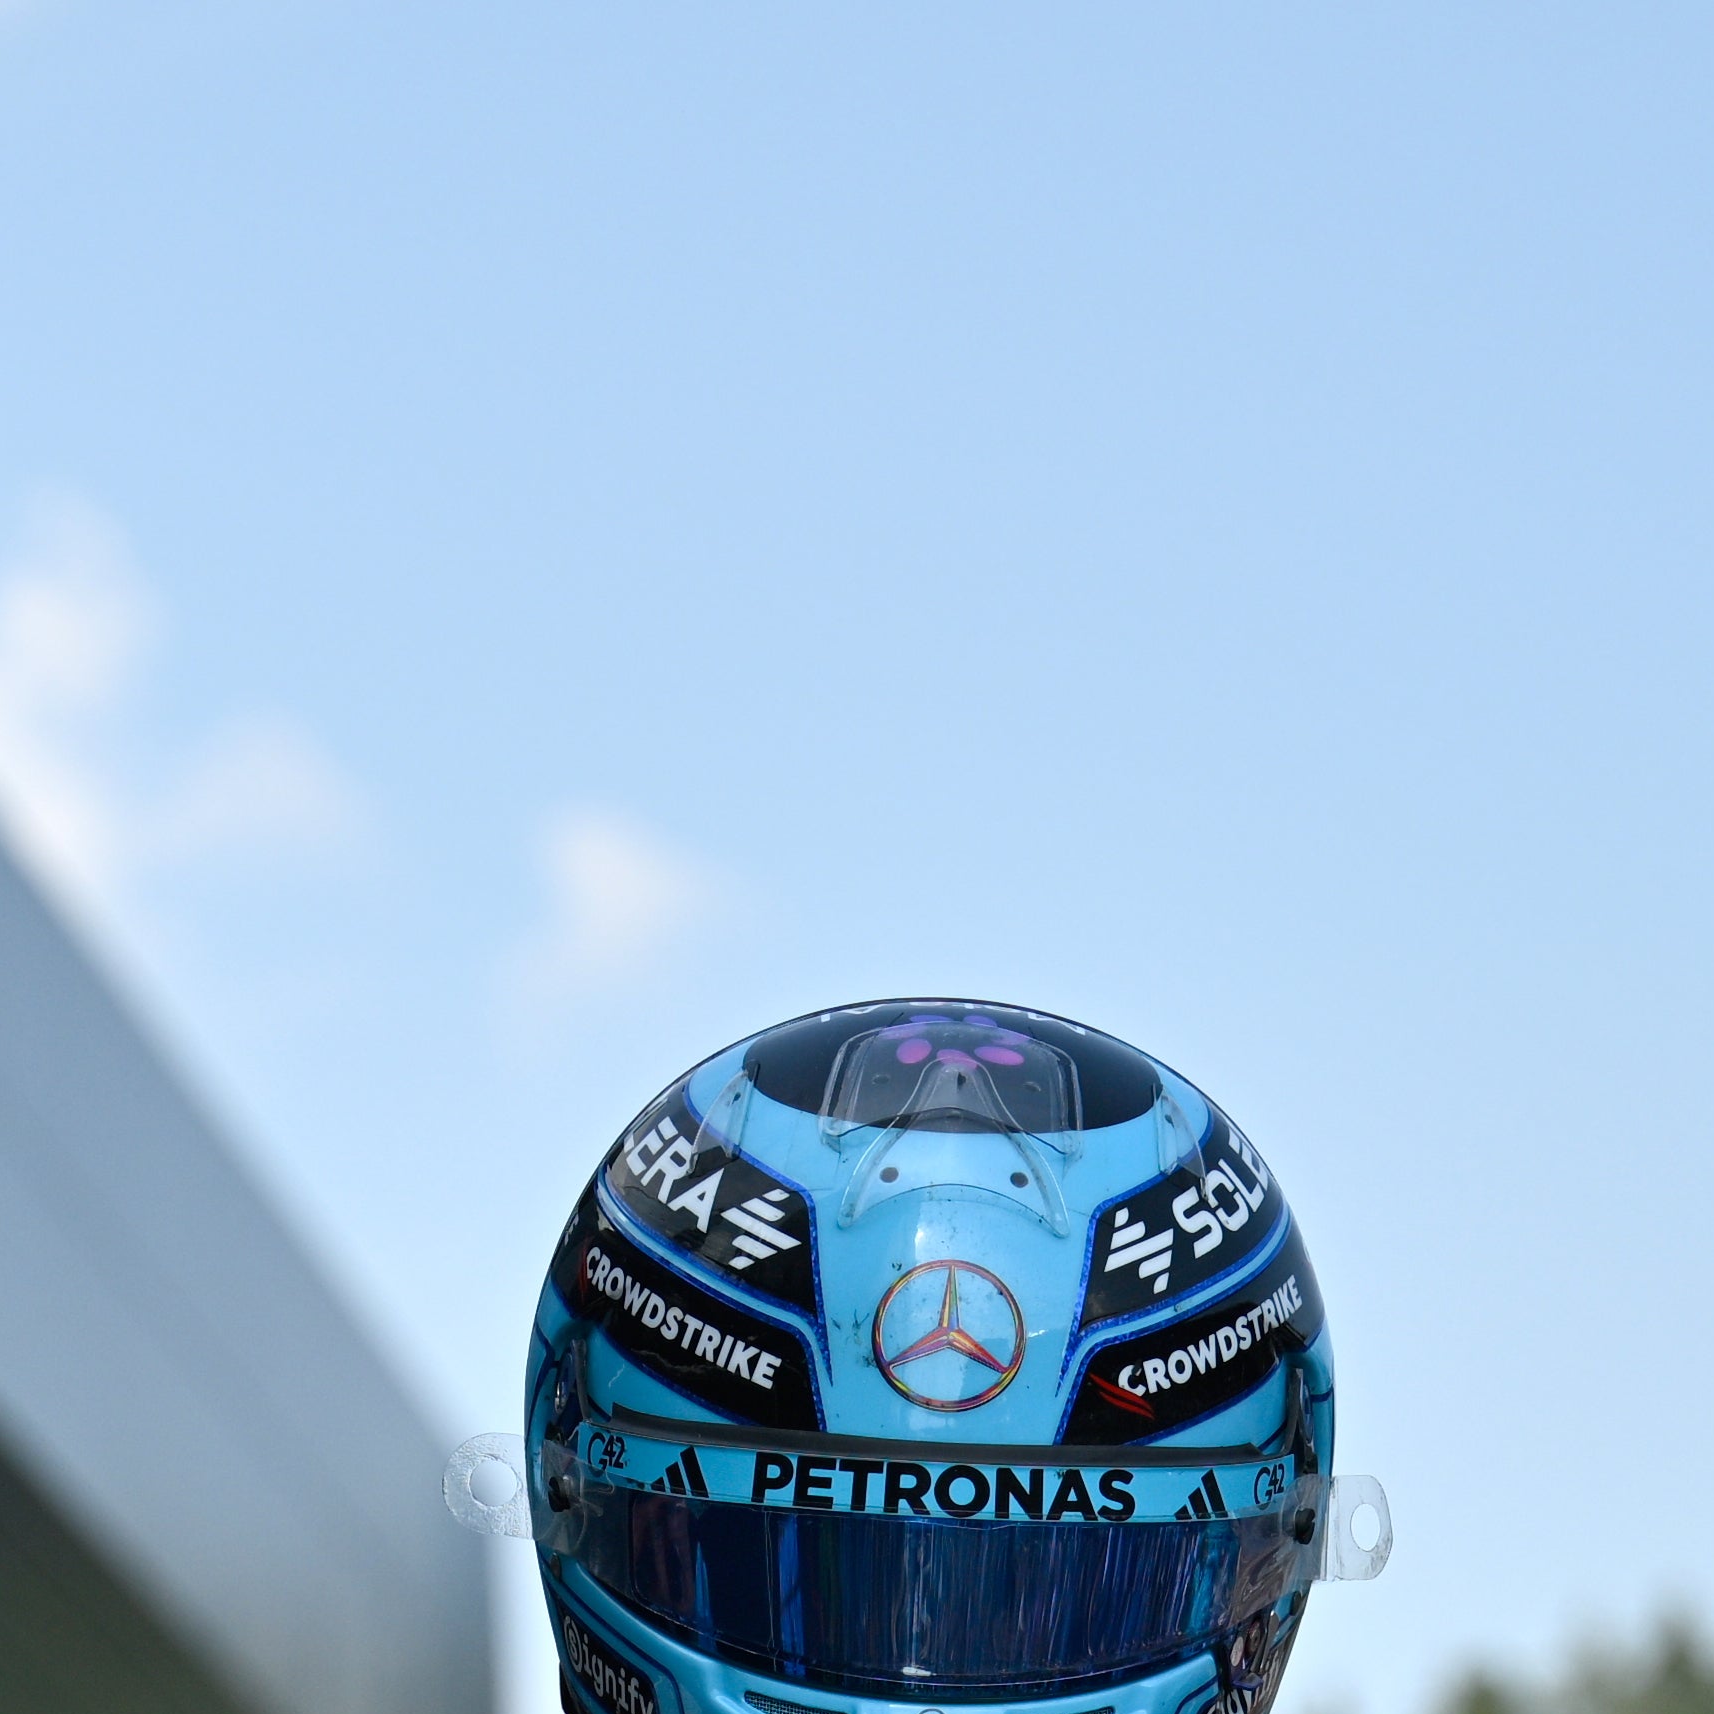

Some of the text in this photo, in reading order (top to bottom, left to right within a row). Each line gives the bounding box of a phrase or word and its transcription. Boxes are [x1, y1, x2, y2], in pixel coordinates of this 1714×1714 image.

[623, 1113, 725, 1234] ERA
[586, 1246, 782, 1390] CROWDSTRIKE
[1117, 1274, 1303, 1397] CROWDSTRIKE
[750, 1450, 1136, 1523] PETRONAS
